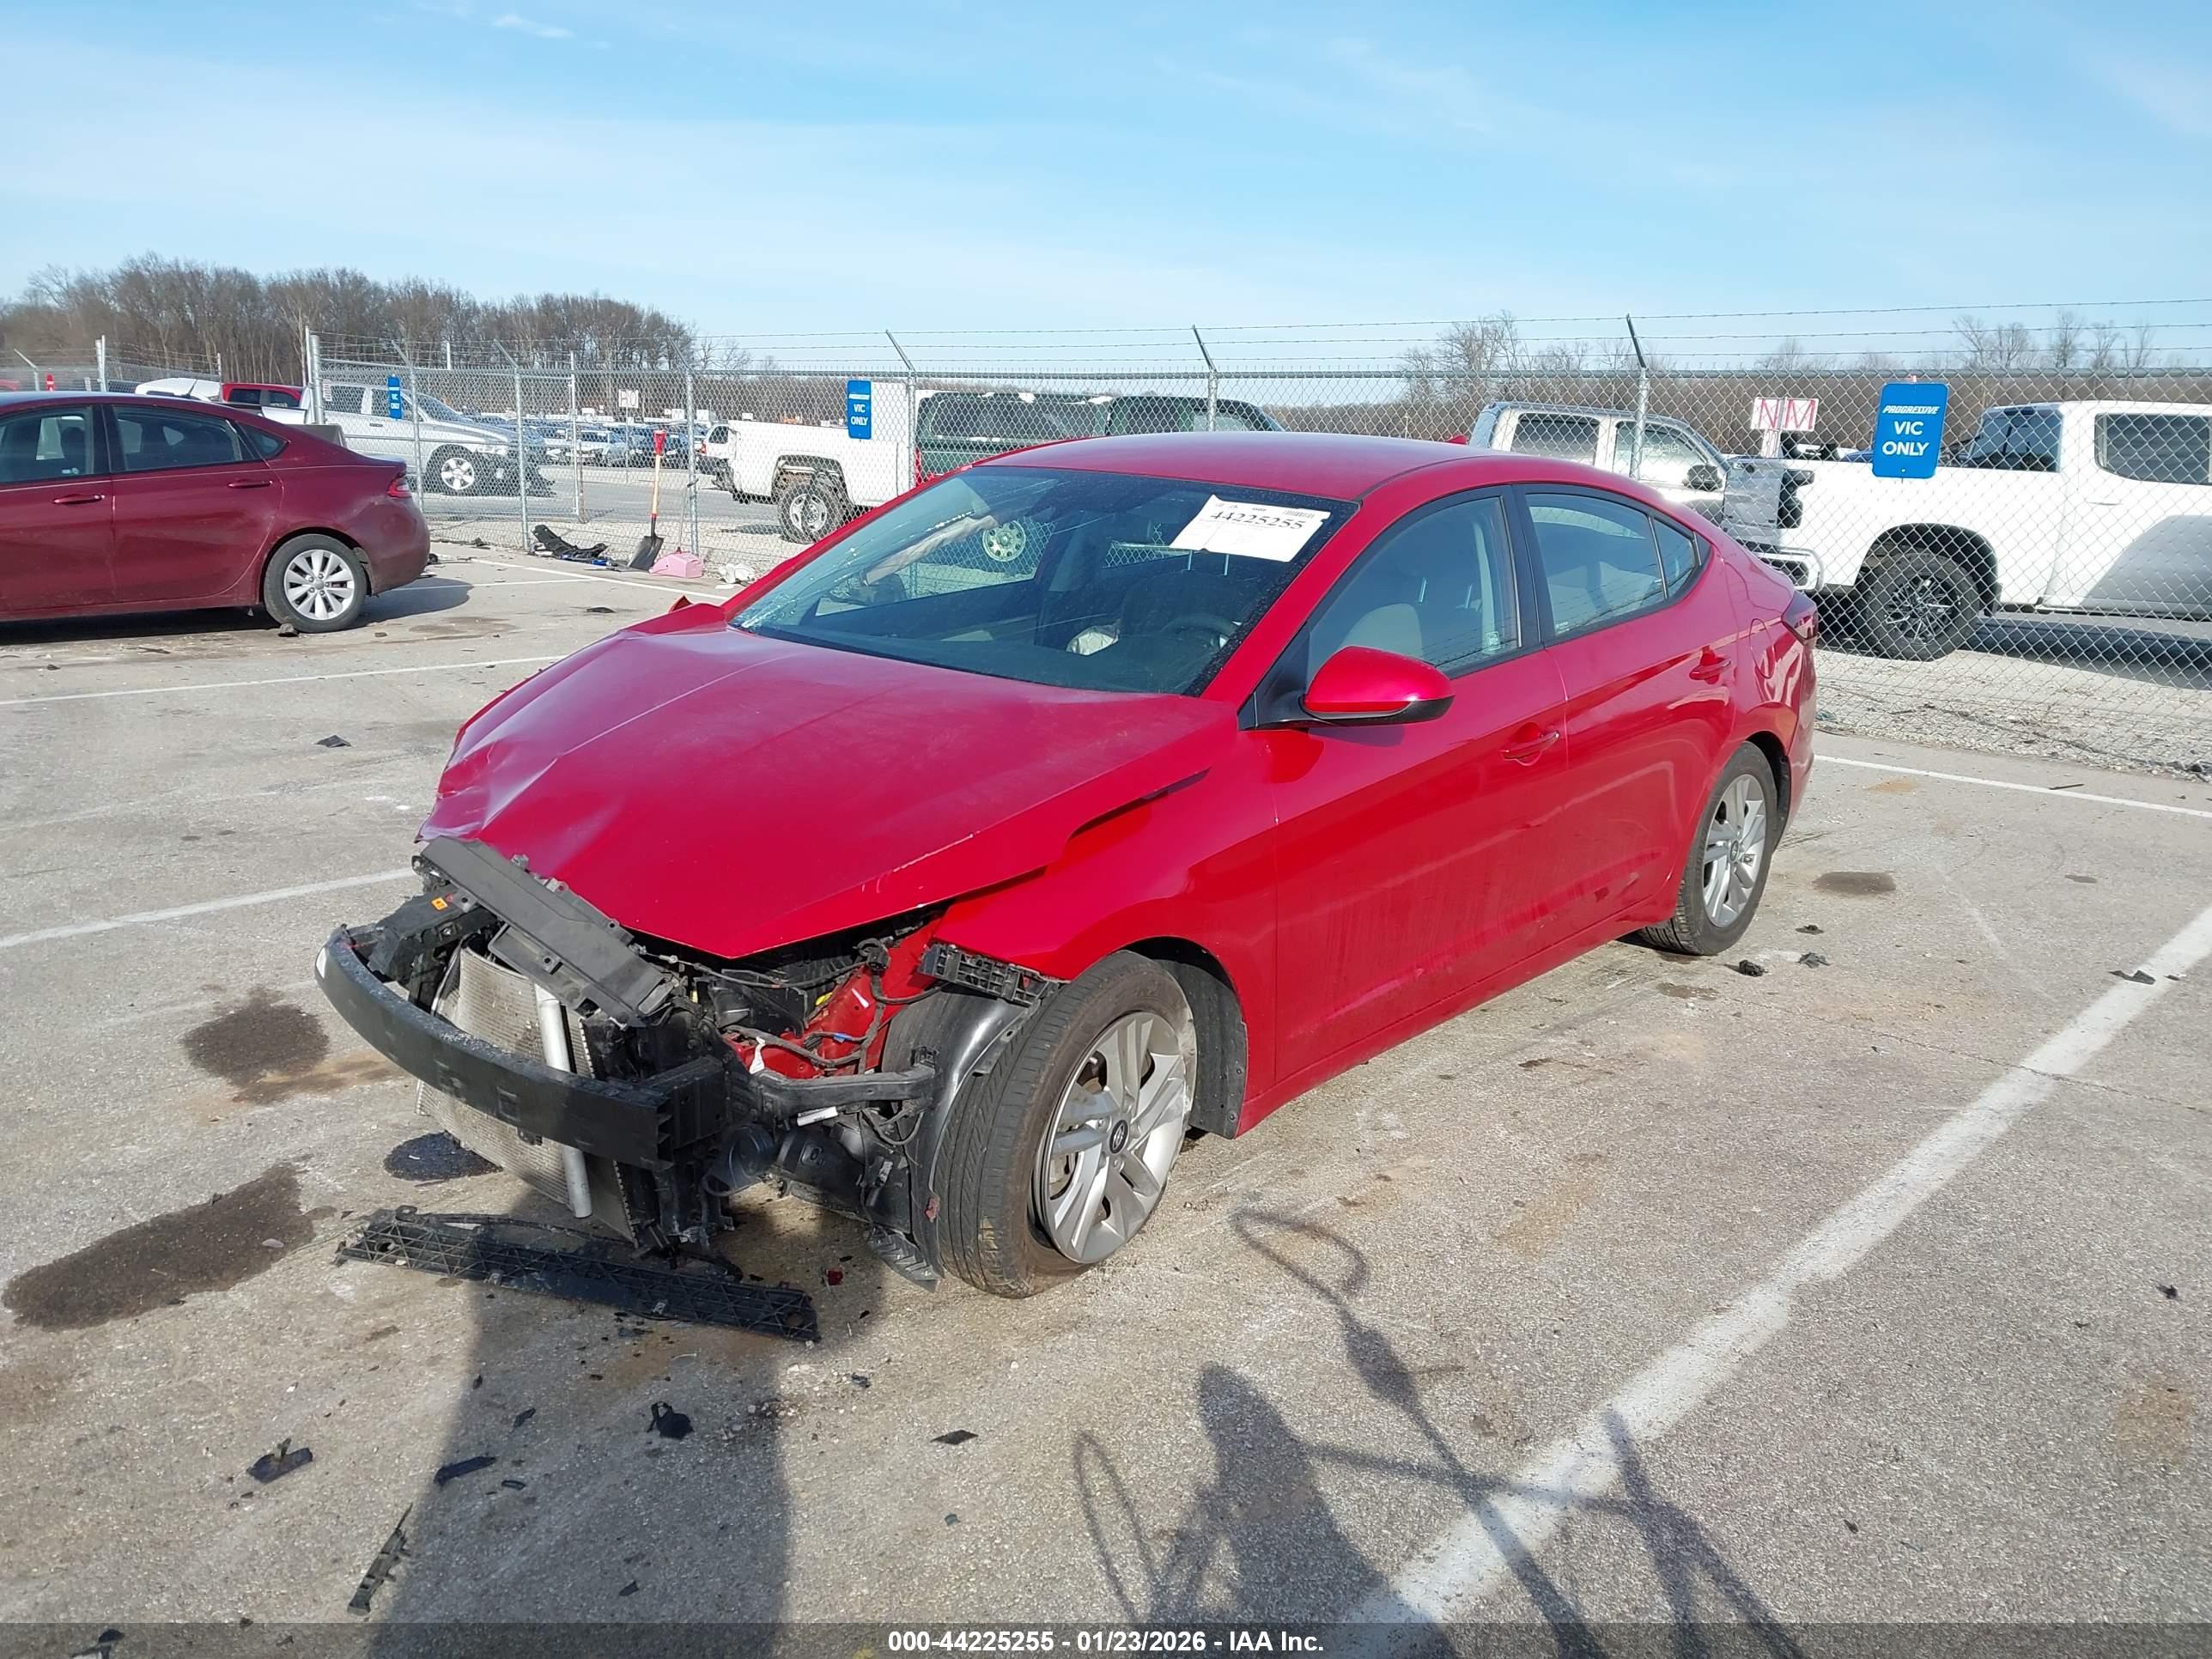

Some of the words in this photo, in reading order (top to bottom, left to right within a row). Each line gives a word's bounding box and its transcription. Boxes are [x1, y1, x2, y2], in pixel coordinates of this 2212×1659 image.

[853, 404, 866, 413] VIC
[1881, 404, 1940, 415] PROGRESSIVE
[850, 416, 868, 426] ONLY
[1894, 421, 1924, 435] VIC
[1881, 441, 1929, 456] ONLY
[1211, 511, 1306, 530] 44225255
